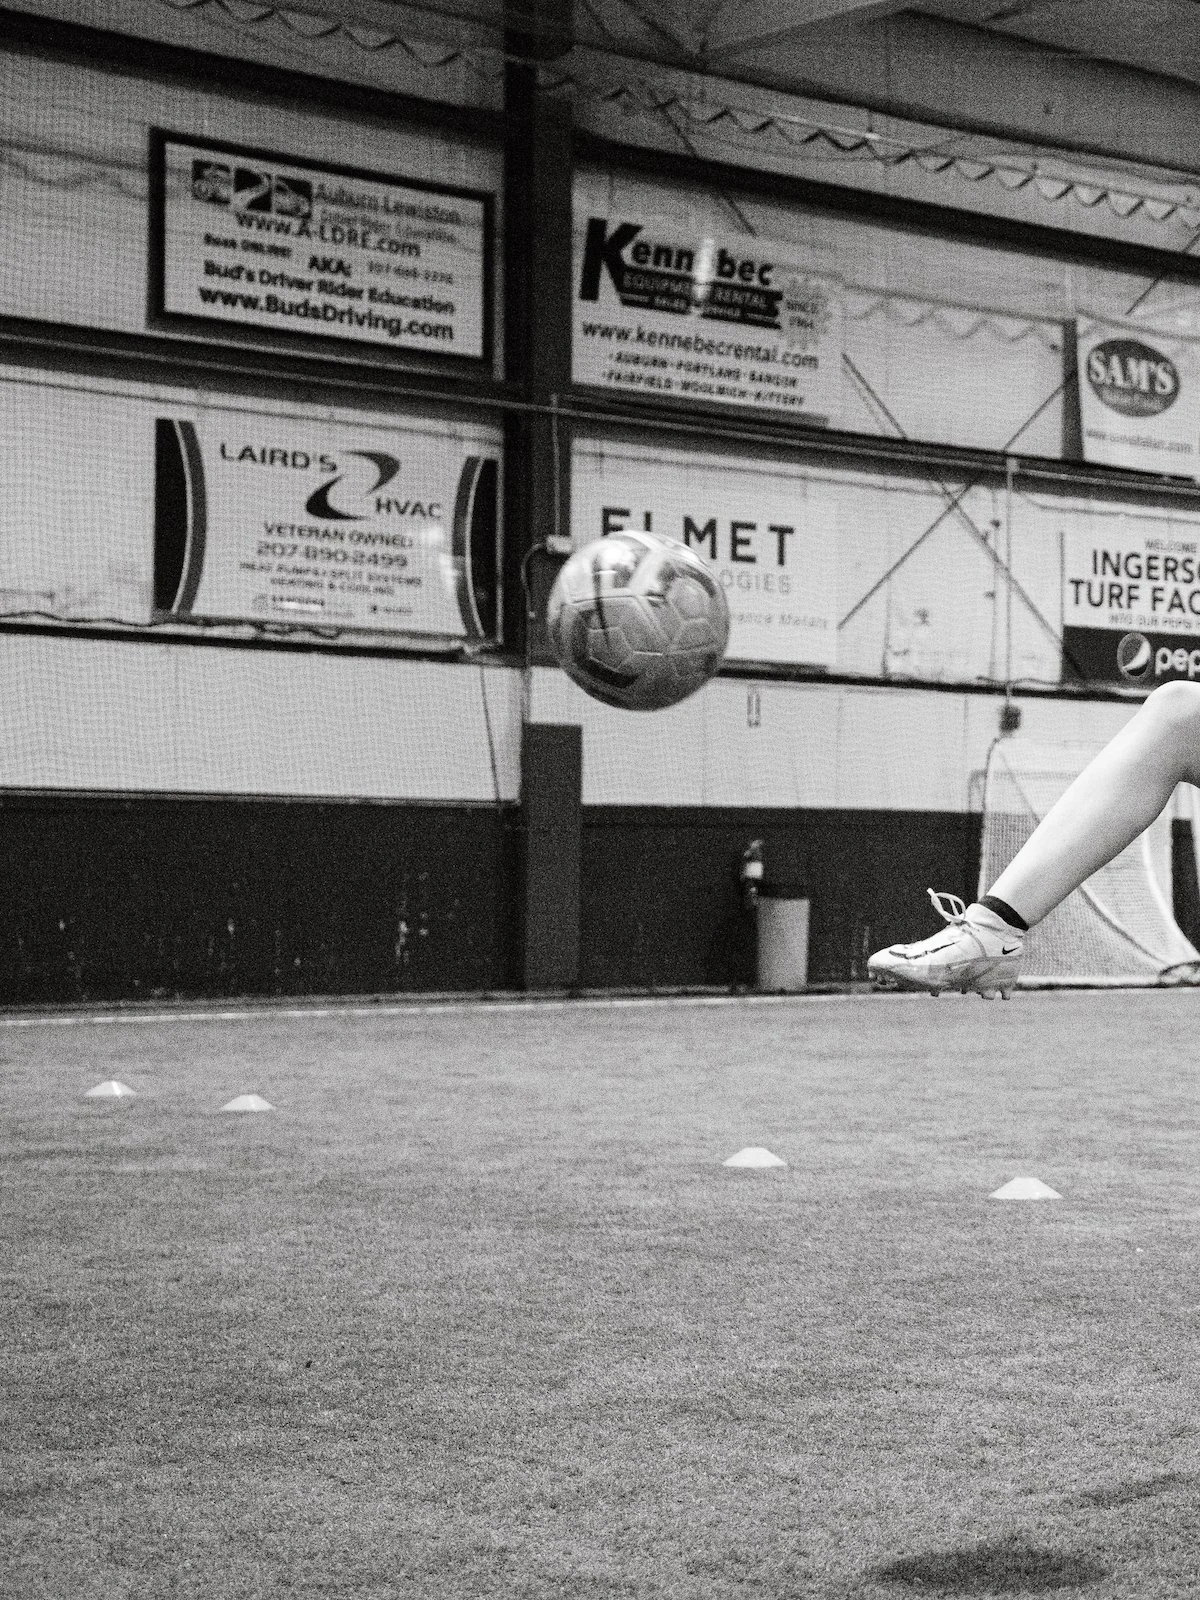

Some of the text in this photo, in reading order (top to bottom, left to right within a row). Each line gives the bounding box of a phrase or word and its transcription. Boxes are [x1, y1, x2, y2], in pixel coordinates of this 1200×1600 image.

[579, 217, 774, 303] Kennbec
[203, 259, 455, 316] Bud's Driver Rider Education
[199, 286, 455, 340] www.BudsDriving.com
[582, 320, 820, 370] www.kennebecrental.com
[1087, 350, 1175, 396] SAM'S
[219, 442, 338, 473] LAIRD'S
[375, 497, 443, 520] HVAC
[264, 521, 414, 549] VETERAN OWNED
[602, 505, 796, 567] EMET
[1069, 577, 1140, 610] TURF
